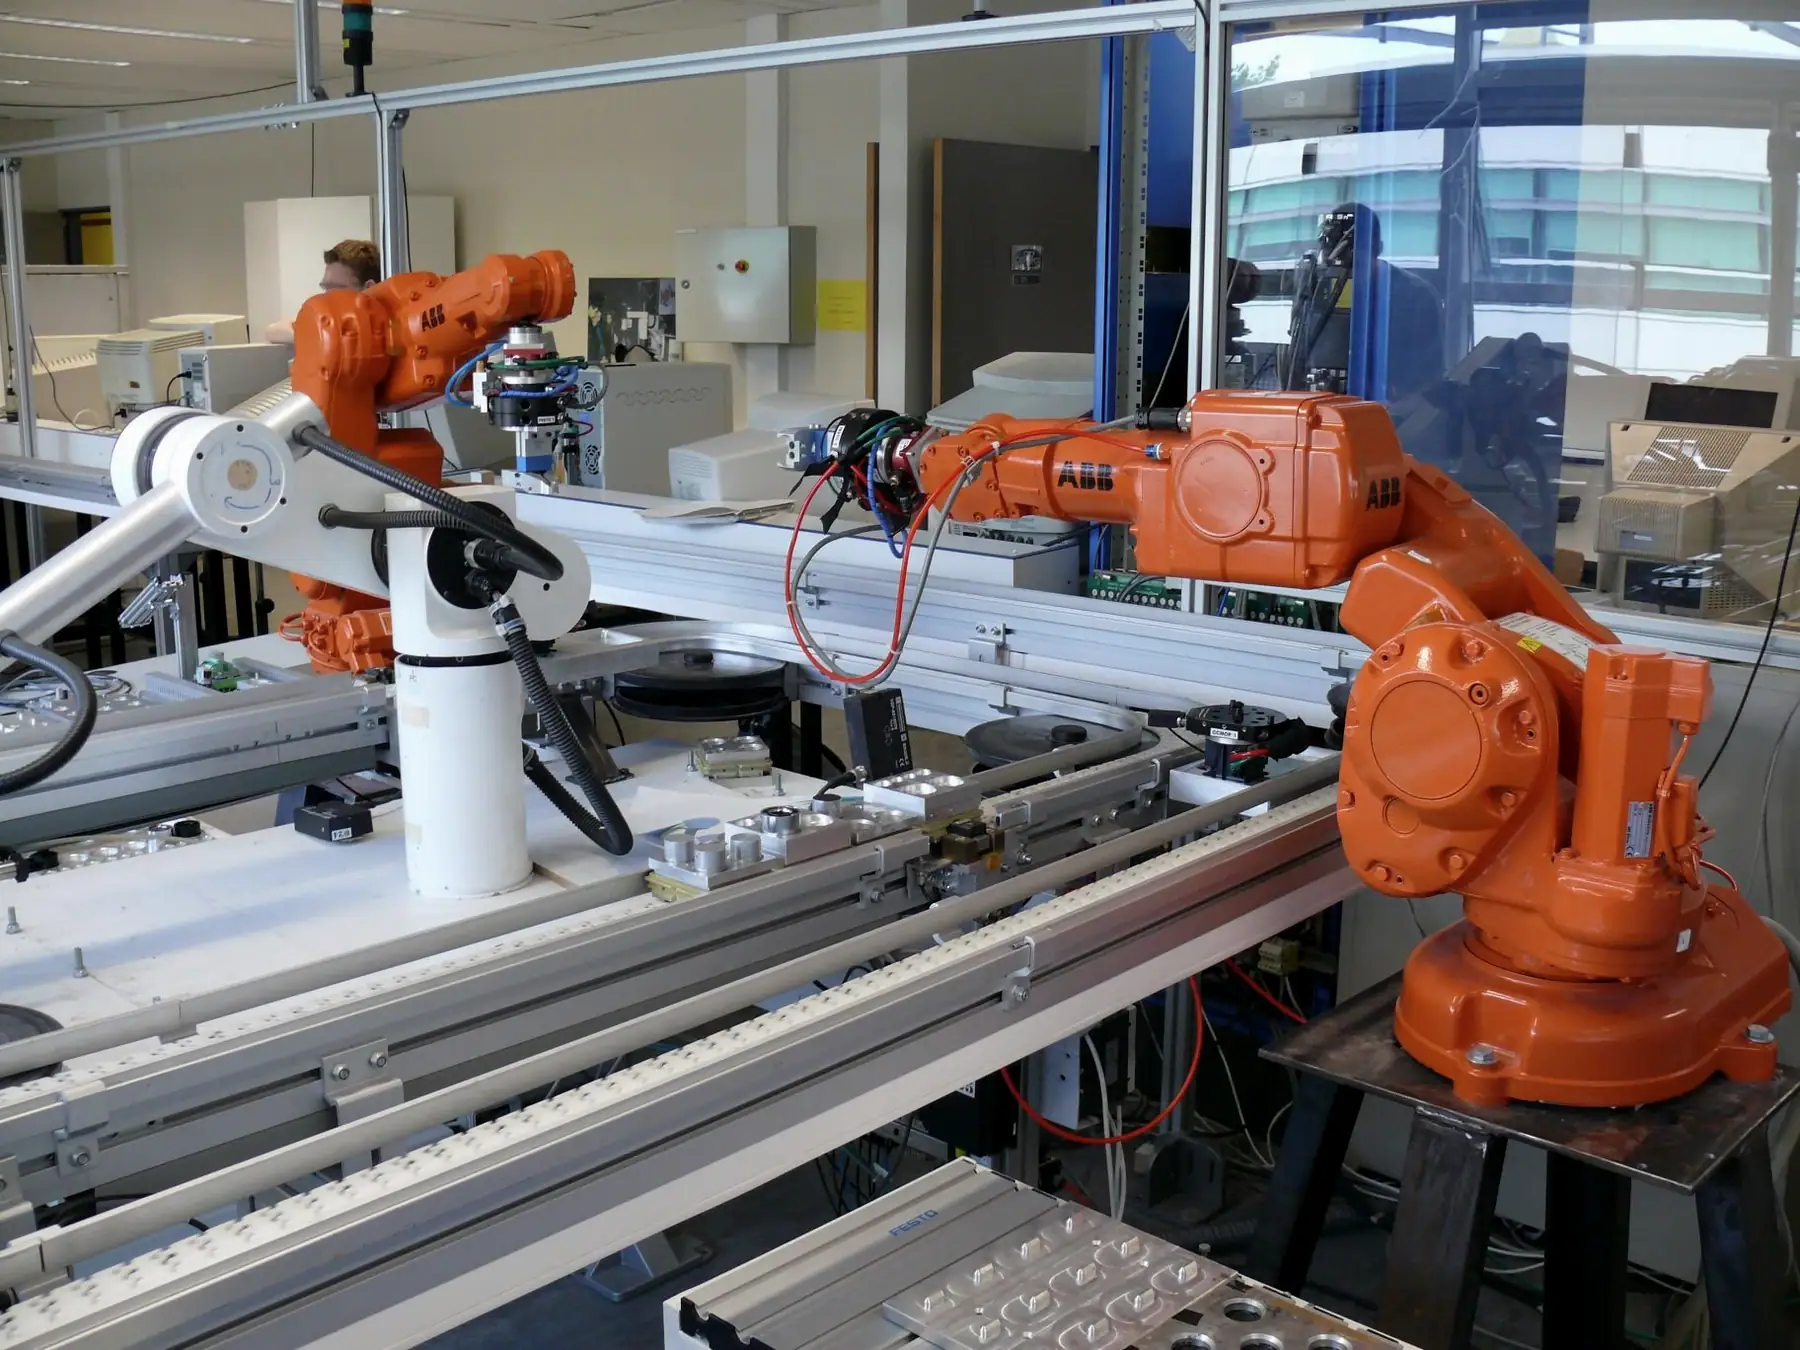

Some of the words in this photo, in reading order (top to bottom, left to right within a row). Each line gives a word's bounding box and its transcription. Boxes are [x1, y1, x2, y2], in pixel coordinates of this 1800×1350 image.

[421, 303, 445, 333] ABB
[1057, 460, 1114, 492] ABB
[1363, 476, 1401, 512] ABB
[889, 1210, 939, 1236] FESTO
